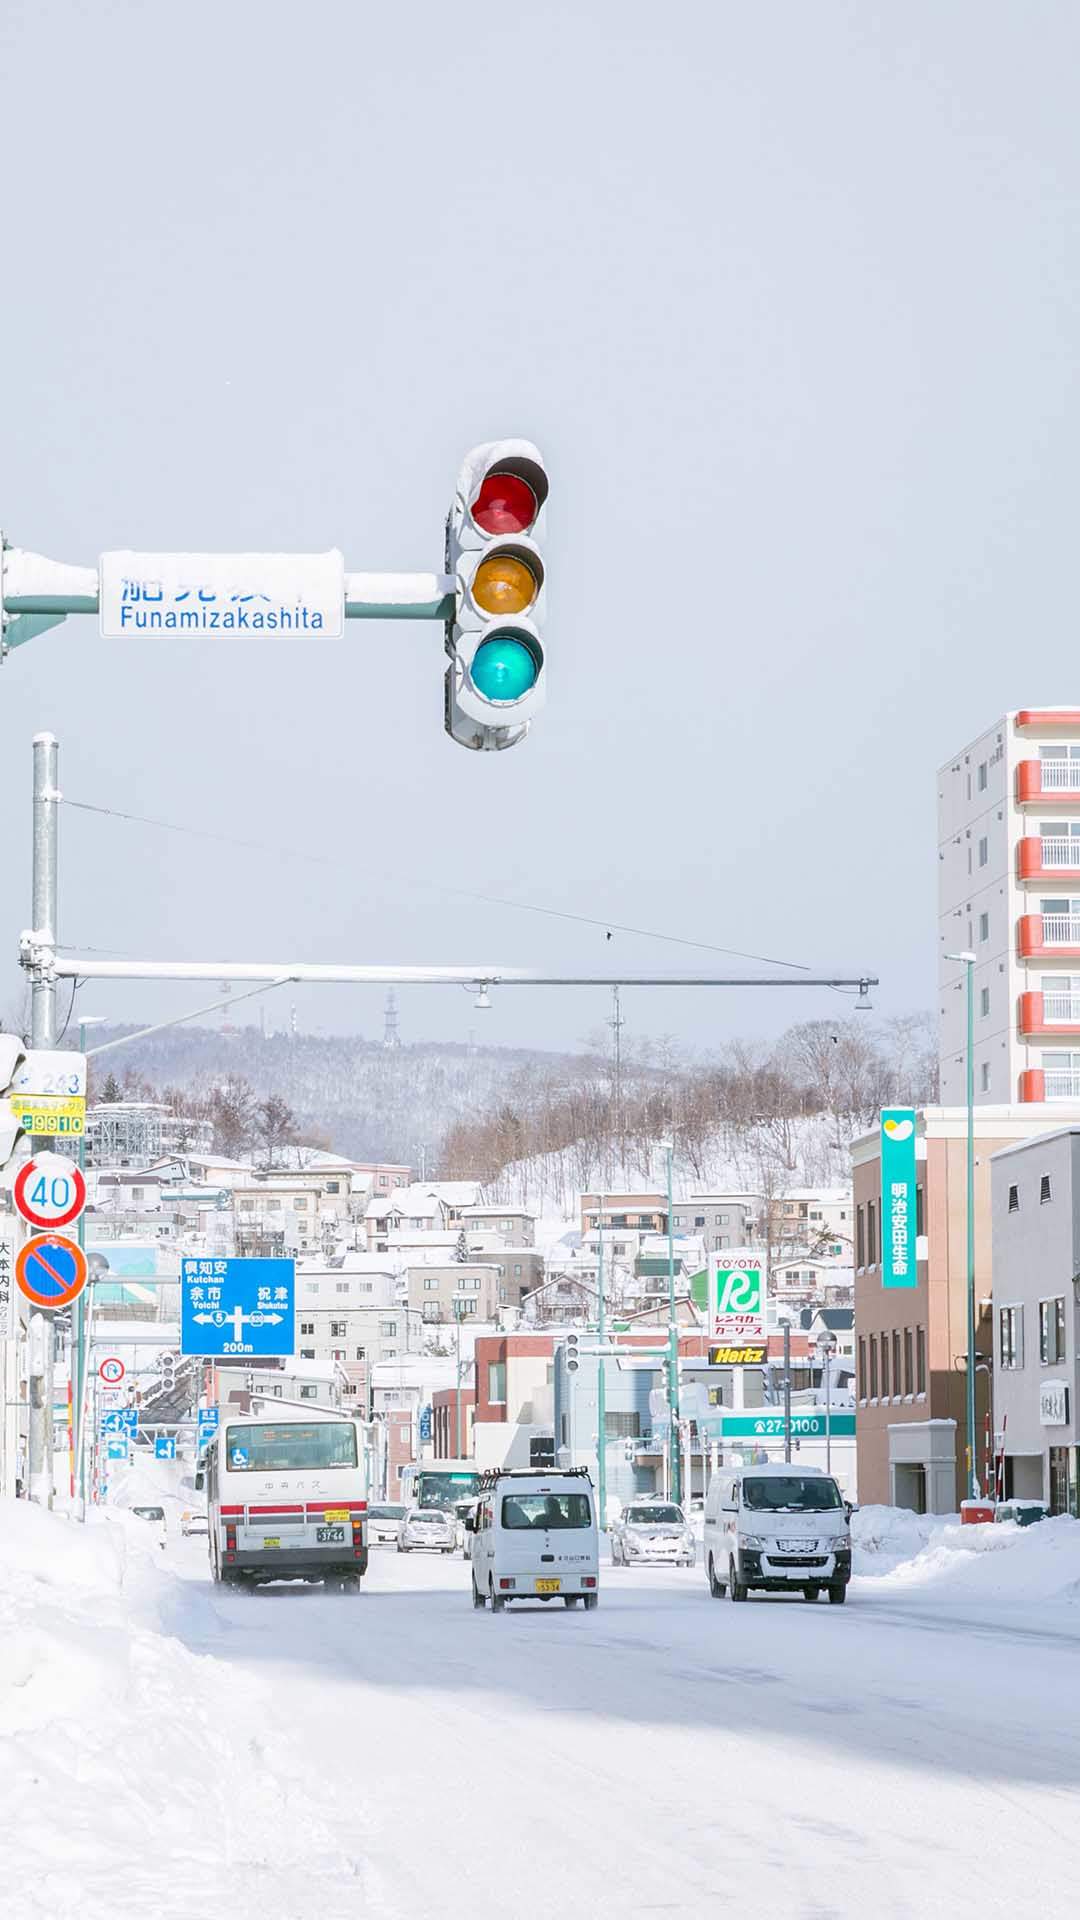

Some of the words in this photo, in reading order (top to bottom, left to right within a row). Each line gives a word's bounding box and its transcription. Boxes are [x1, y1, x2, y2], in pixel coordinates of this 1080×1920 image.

[121, 606, 324, 629] Funamizakashita
[31, 1176, 69, 1208] 40
[891, 1183, 908, 1276] 明治安田生命
[716, 1259, 762, 1269] TOYOTA
[187, 1276, 225, 1284] Kutchan
[190, 1287, 221, 1301] 余市
[258, 1287, 289, 1301] 祝津
[192, 1301, 220, 1310] Yoichi
[215, 1314, 223, 1322] 5
[715, 1315, 762, 1323] レンタカー
[715, 1327, 762, 1335] カーリース
[223, 1342, 254, 1353] 200m
[715, 1347, 765, 1364] Hertz
